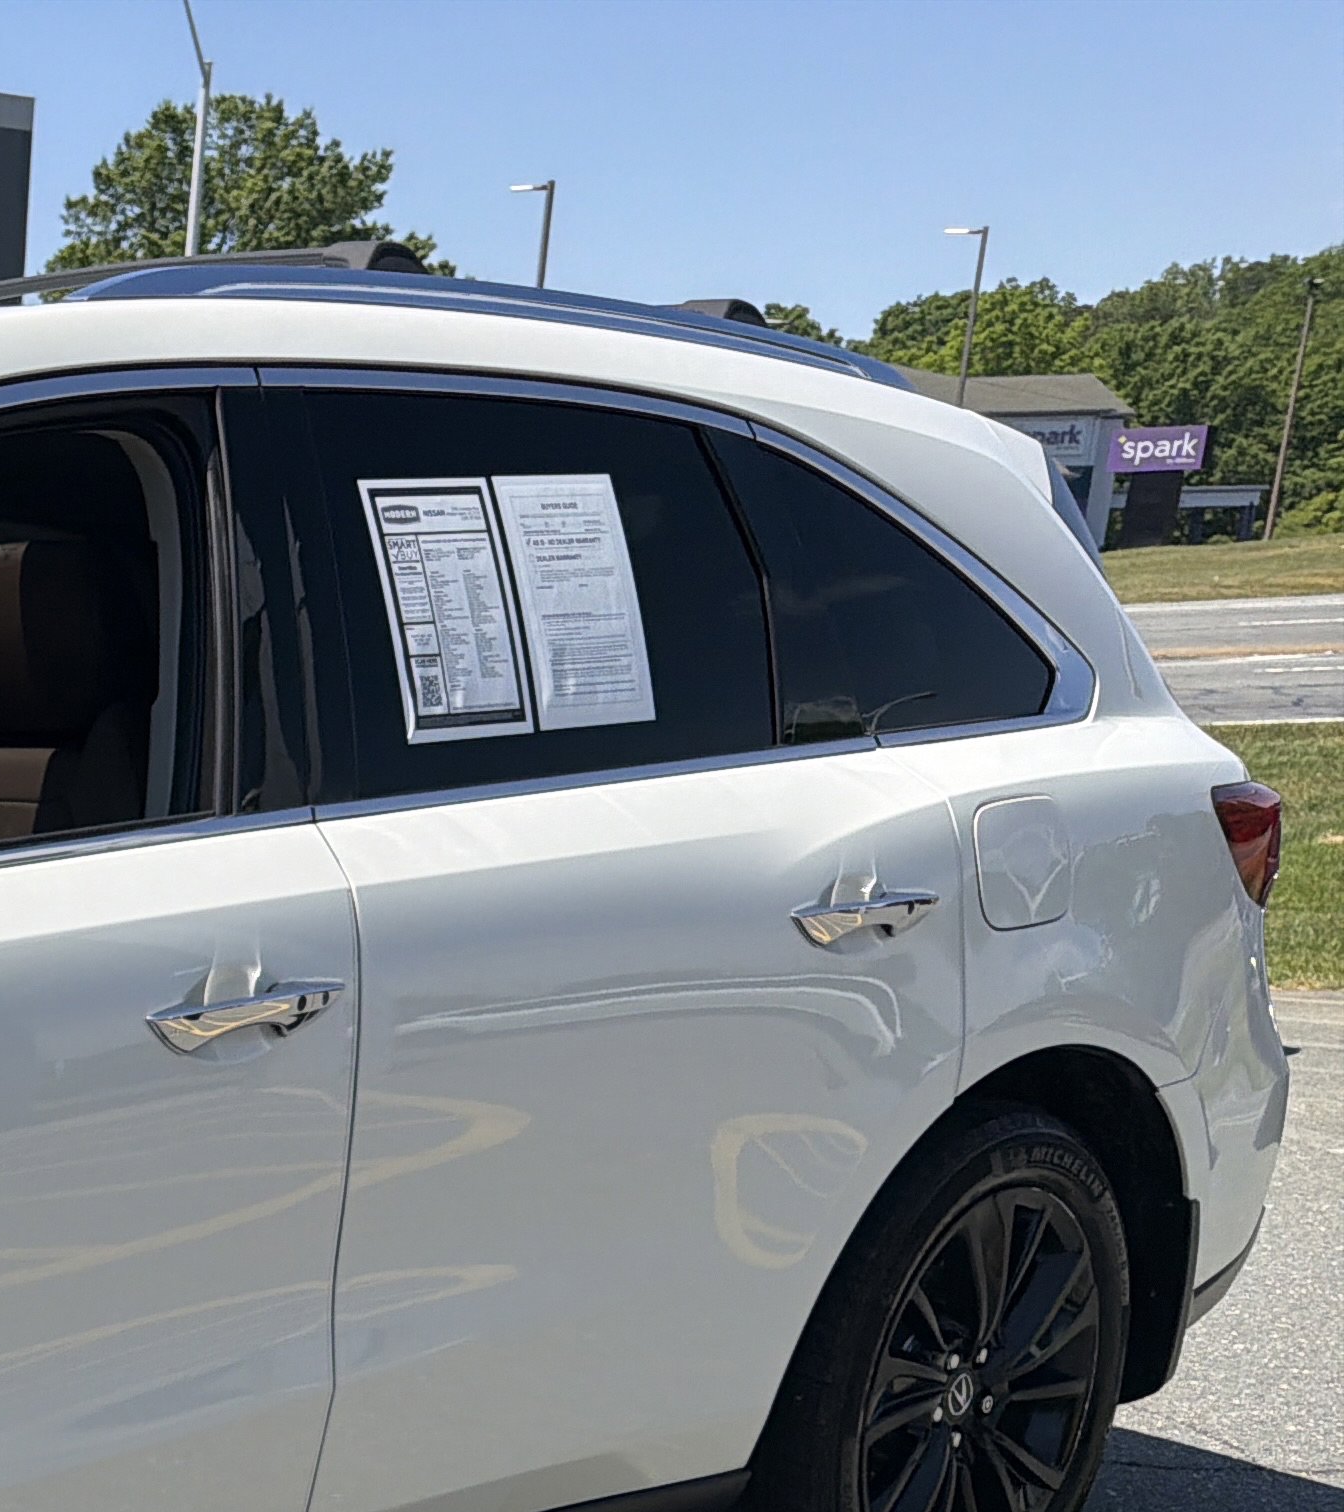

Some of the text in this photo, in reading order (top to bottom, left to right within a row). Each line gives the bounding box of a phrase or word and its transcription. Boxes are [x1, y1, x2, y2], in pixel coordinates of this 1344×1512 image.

[1121, 431, 1199, 466] spark
[383, 509, 417, 519] MODERN
[387, 539, 417, 550] SMART
[1032, 1145, 1106, 1198] MICHELIN
